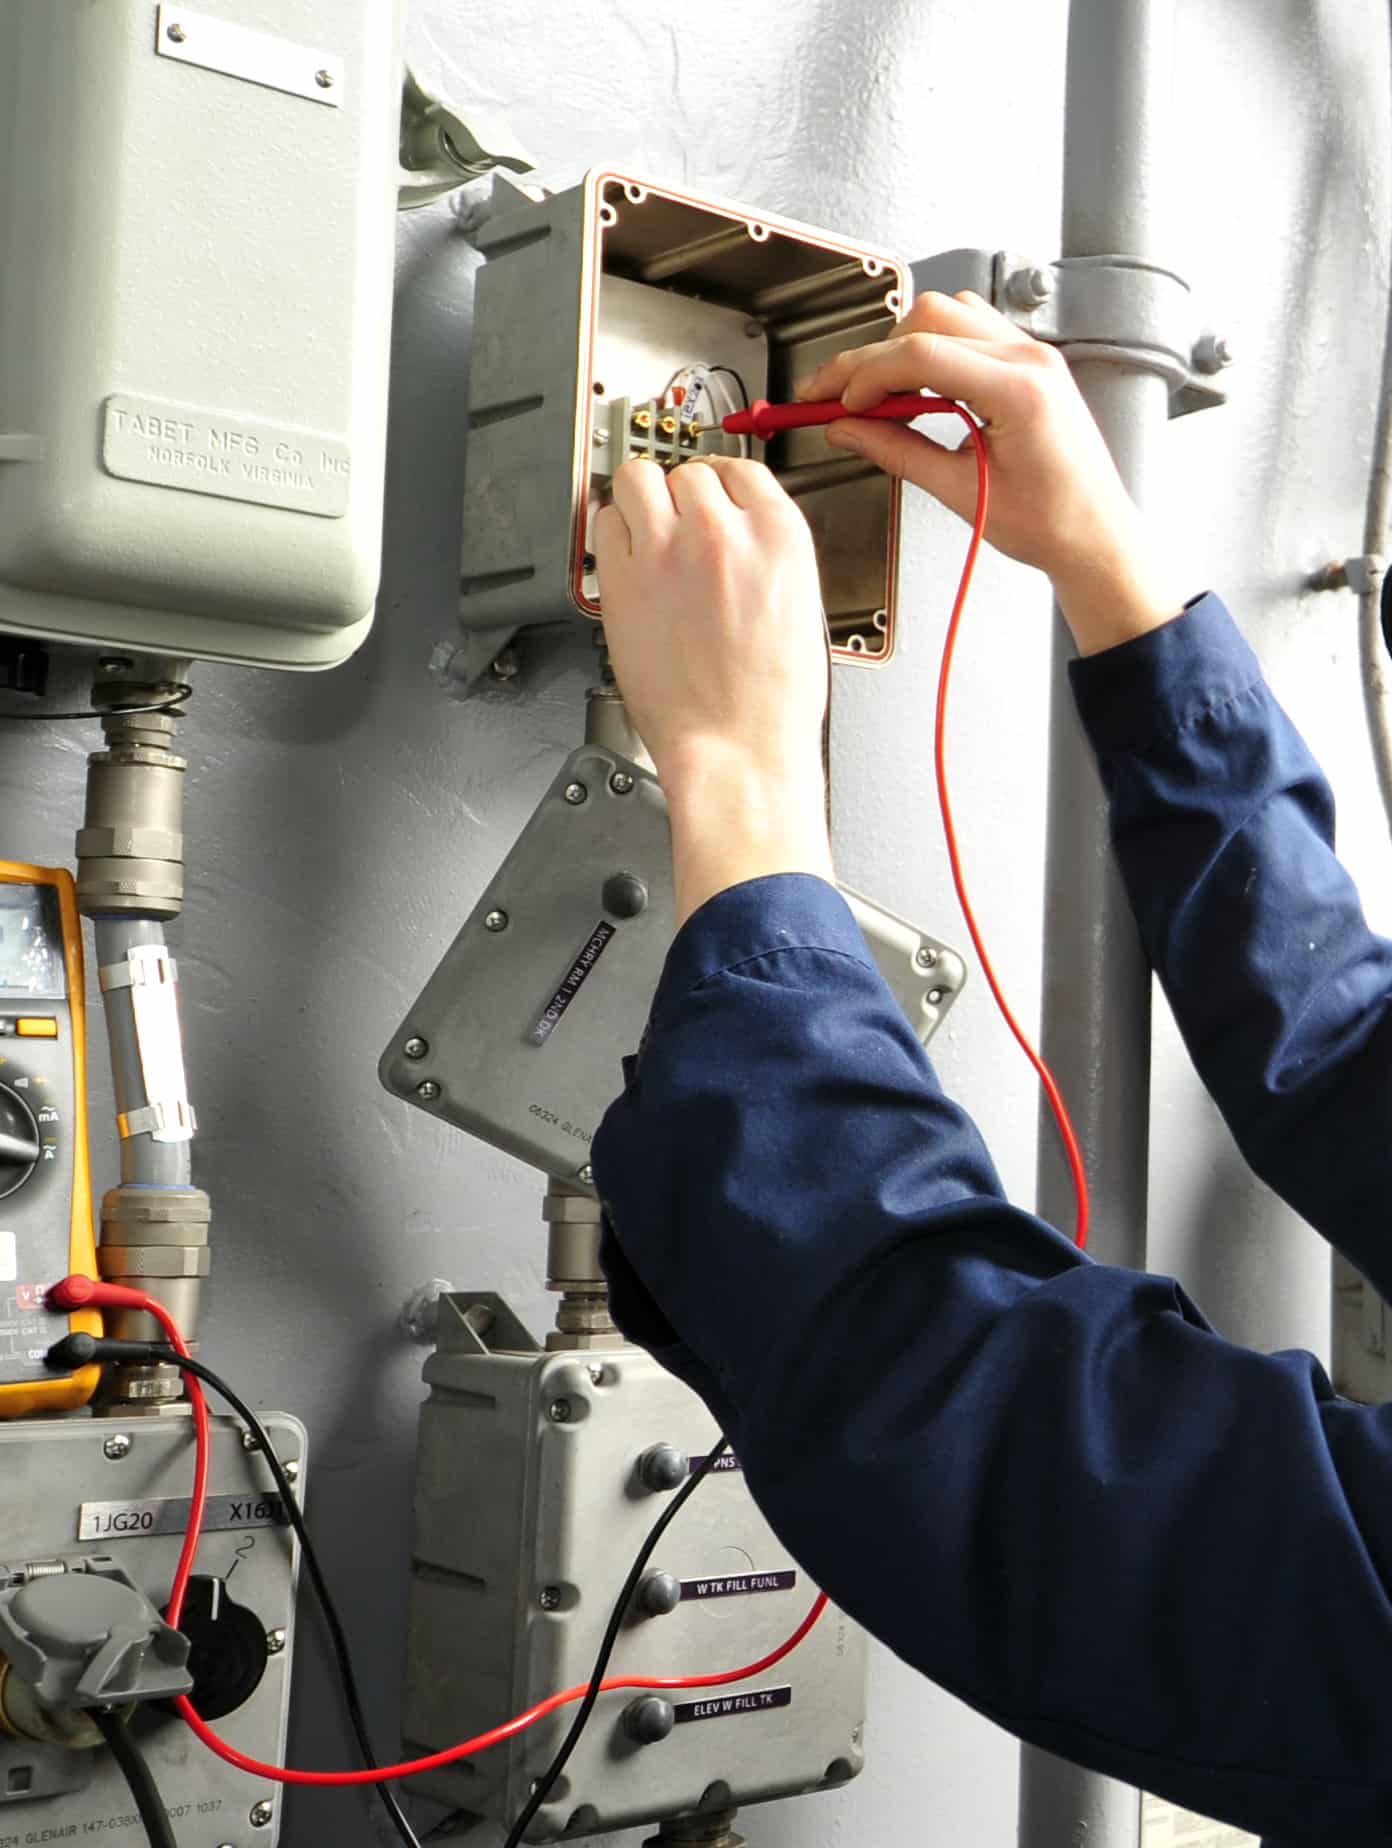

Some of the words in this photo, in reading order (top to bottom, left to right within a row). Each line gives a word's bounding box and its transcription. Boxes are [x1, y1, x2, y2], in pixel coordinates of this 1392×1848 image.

[112, 409, 195, 442] TABET
[208, 428, 259, 457] MFG
[147, 447, 231, 477] NORFOLK
[241, 462, 314, 490] VIRGINIA
[579, 927, 610, 968] MCHRY
[567, 967, 584, 986] RM
[546, 994, 566, 1020] 2ND
[93, 1512, 153, 1533] 1JG20
[235, 1535, 256, 1559] 2
[696, 1583, 708, 1594] W
[710, 1582, 724, 1593] TK
[726, 1579, 748, 1592] FILL
[751, 1576, 779, 1589] FUNL
[693, 1702, 720, 1716] ELEV
[722, 1700, 733, 1711] W
[735, 1697, 758, 1709] FILL
[760, 1694, 774, 1704] TK
[25, 1824, 78, 1844] GLENAIR
